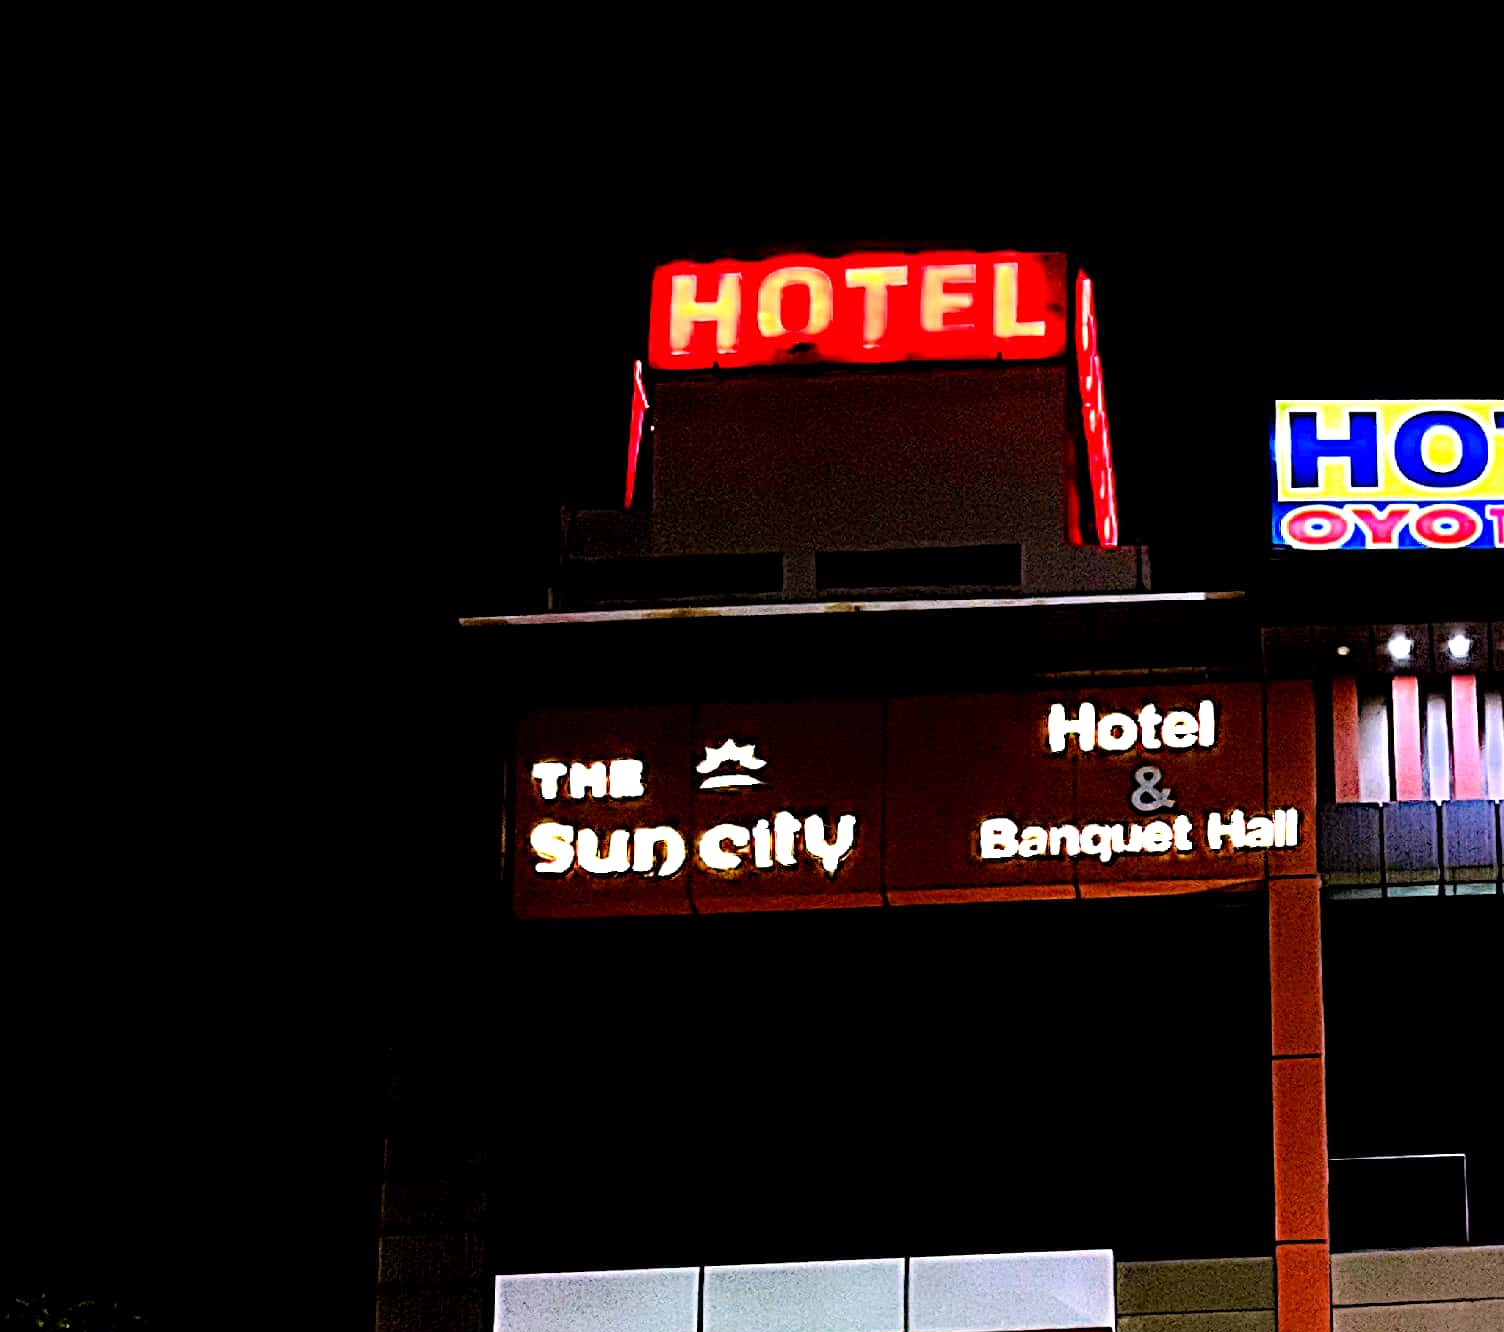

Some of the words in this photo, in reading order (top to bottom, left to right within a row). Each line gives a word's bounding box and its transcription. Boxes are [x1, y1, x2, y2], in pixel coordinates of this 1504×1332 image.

[669, 262, 1047, 354] HOTEL
[1286, 504, 1482, 547] OYO
[1048, 700, 1215, 752] Hotel
[531, 759, 643, 799] THE
[1130, 766, 1175, 811] &
[530, 822, 684, 879] Sun
[698, 811, 856, 875] city
[979, 816, 1192, 862] Banquet
[1208, 808, 1299, 850] Hall
